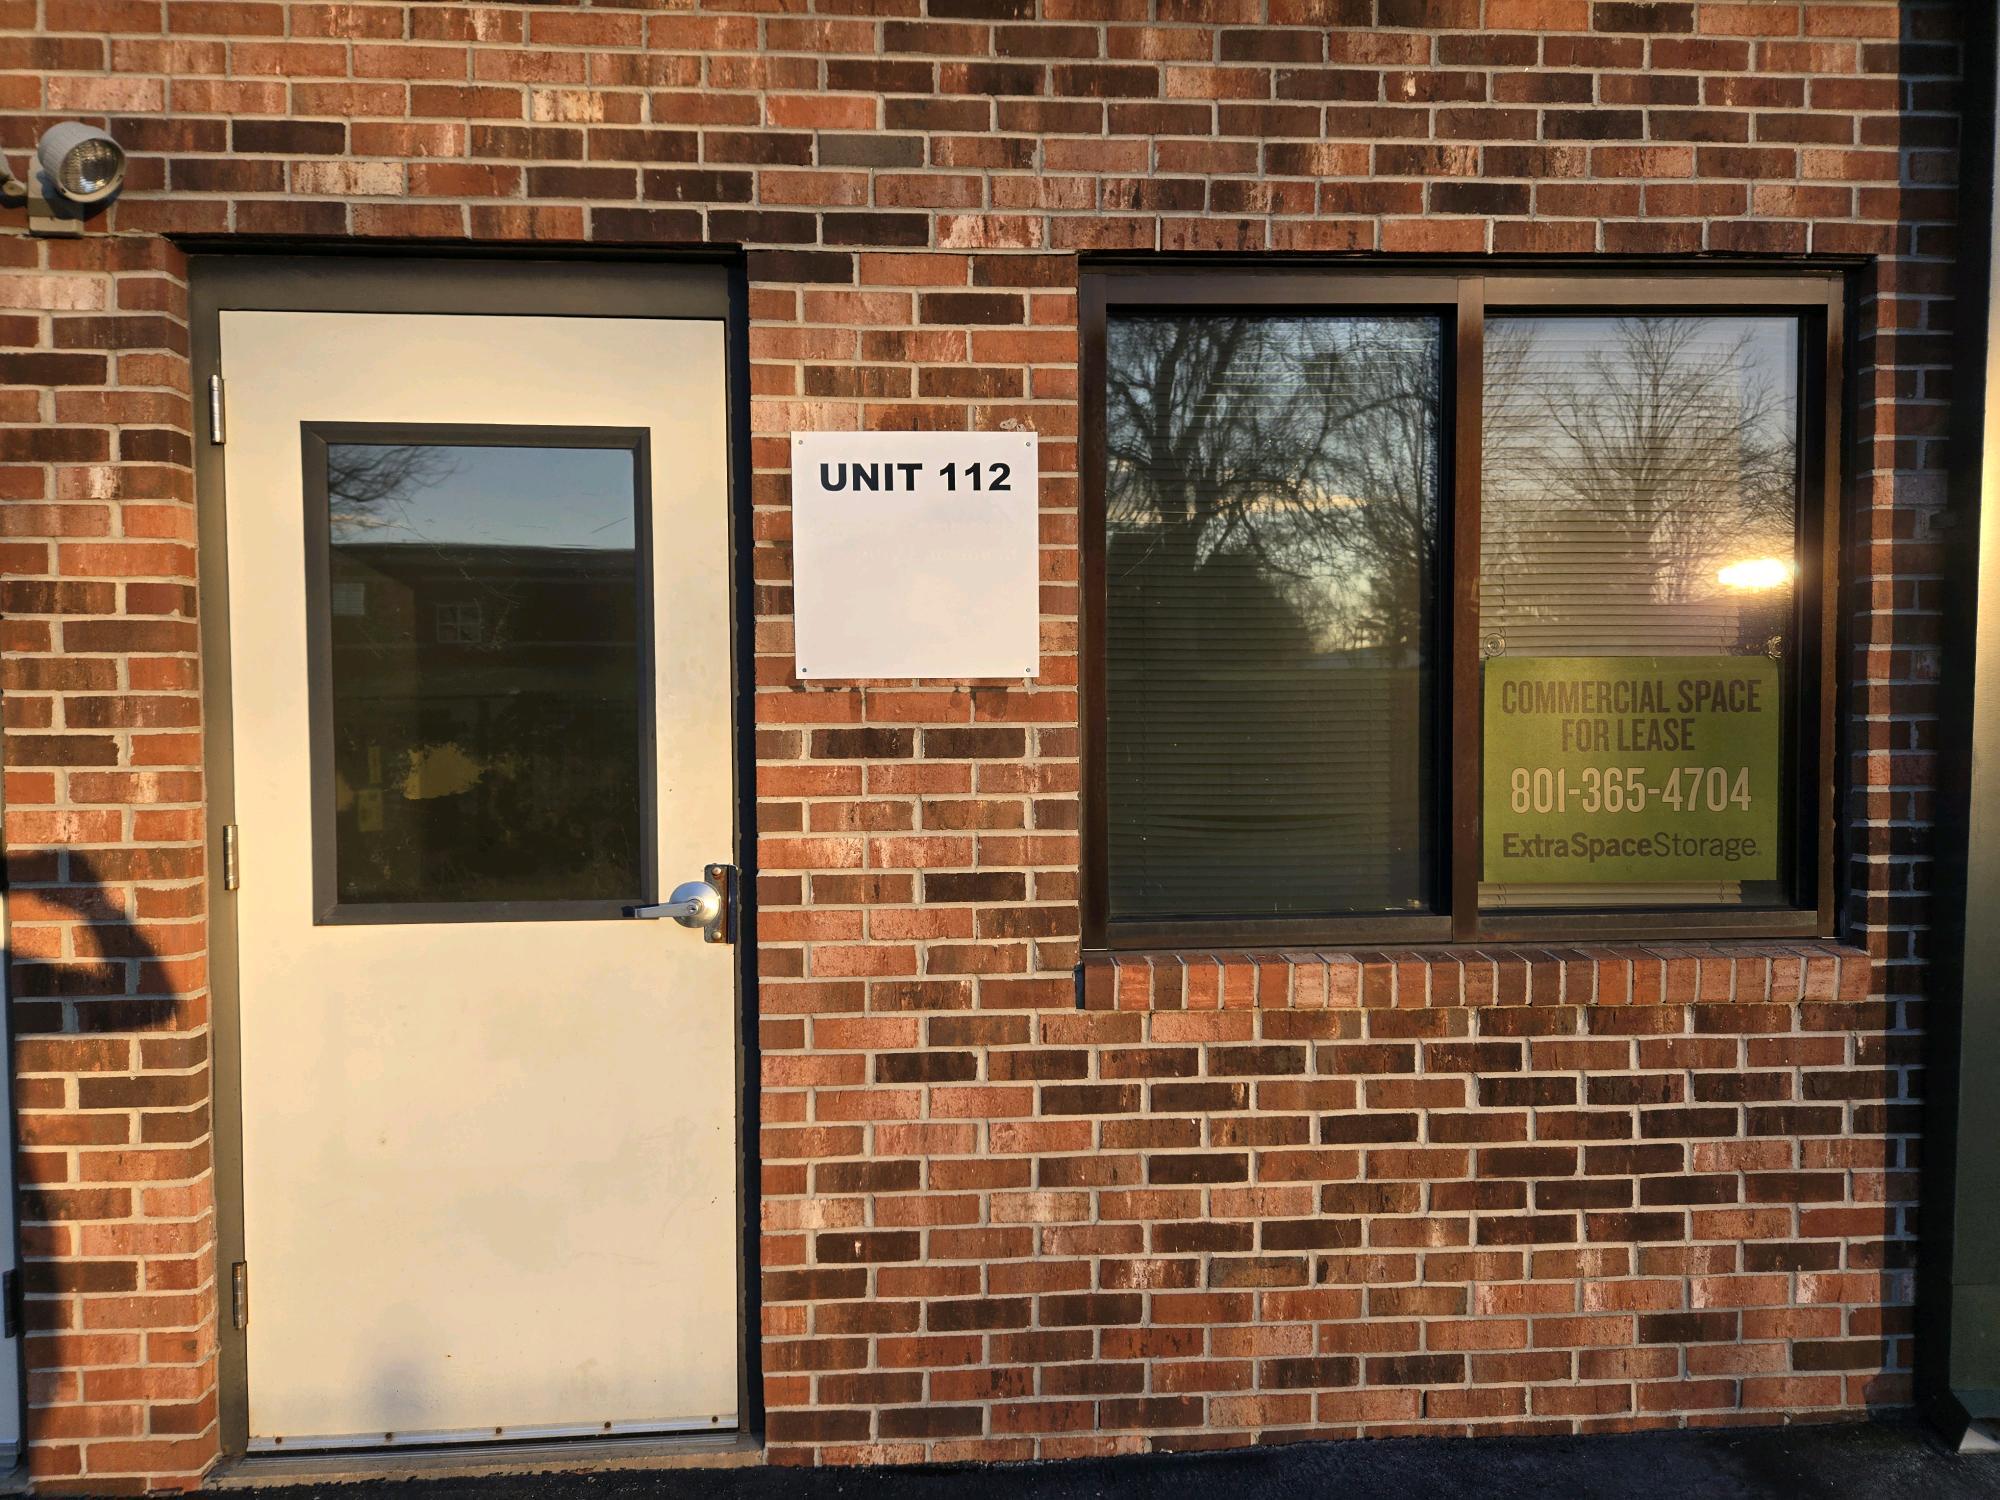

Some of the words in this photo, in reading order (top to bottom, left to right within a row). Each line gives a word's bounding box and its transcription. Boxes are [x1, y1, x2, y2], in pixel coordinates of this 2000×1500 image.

[820, 463, 923, 491] UNIT
[939, 462, 1011, 491] 112
[1502, 680, 1671, 714] COMMERCIAL
[1678, 679, 1762, 713] SPACE
[1562, 718, 1609, 751] FOR
[1618, 718, 1696, 751] LEASE
[1511, 767, 1752, 813] 801-365-4704
